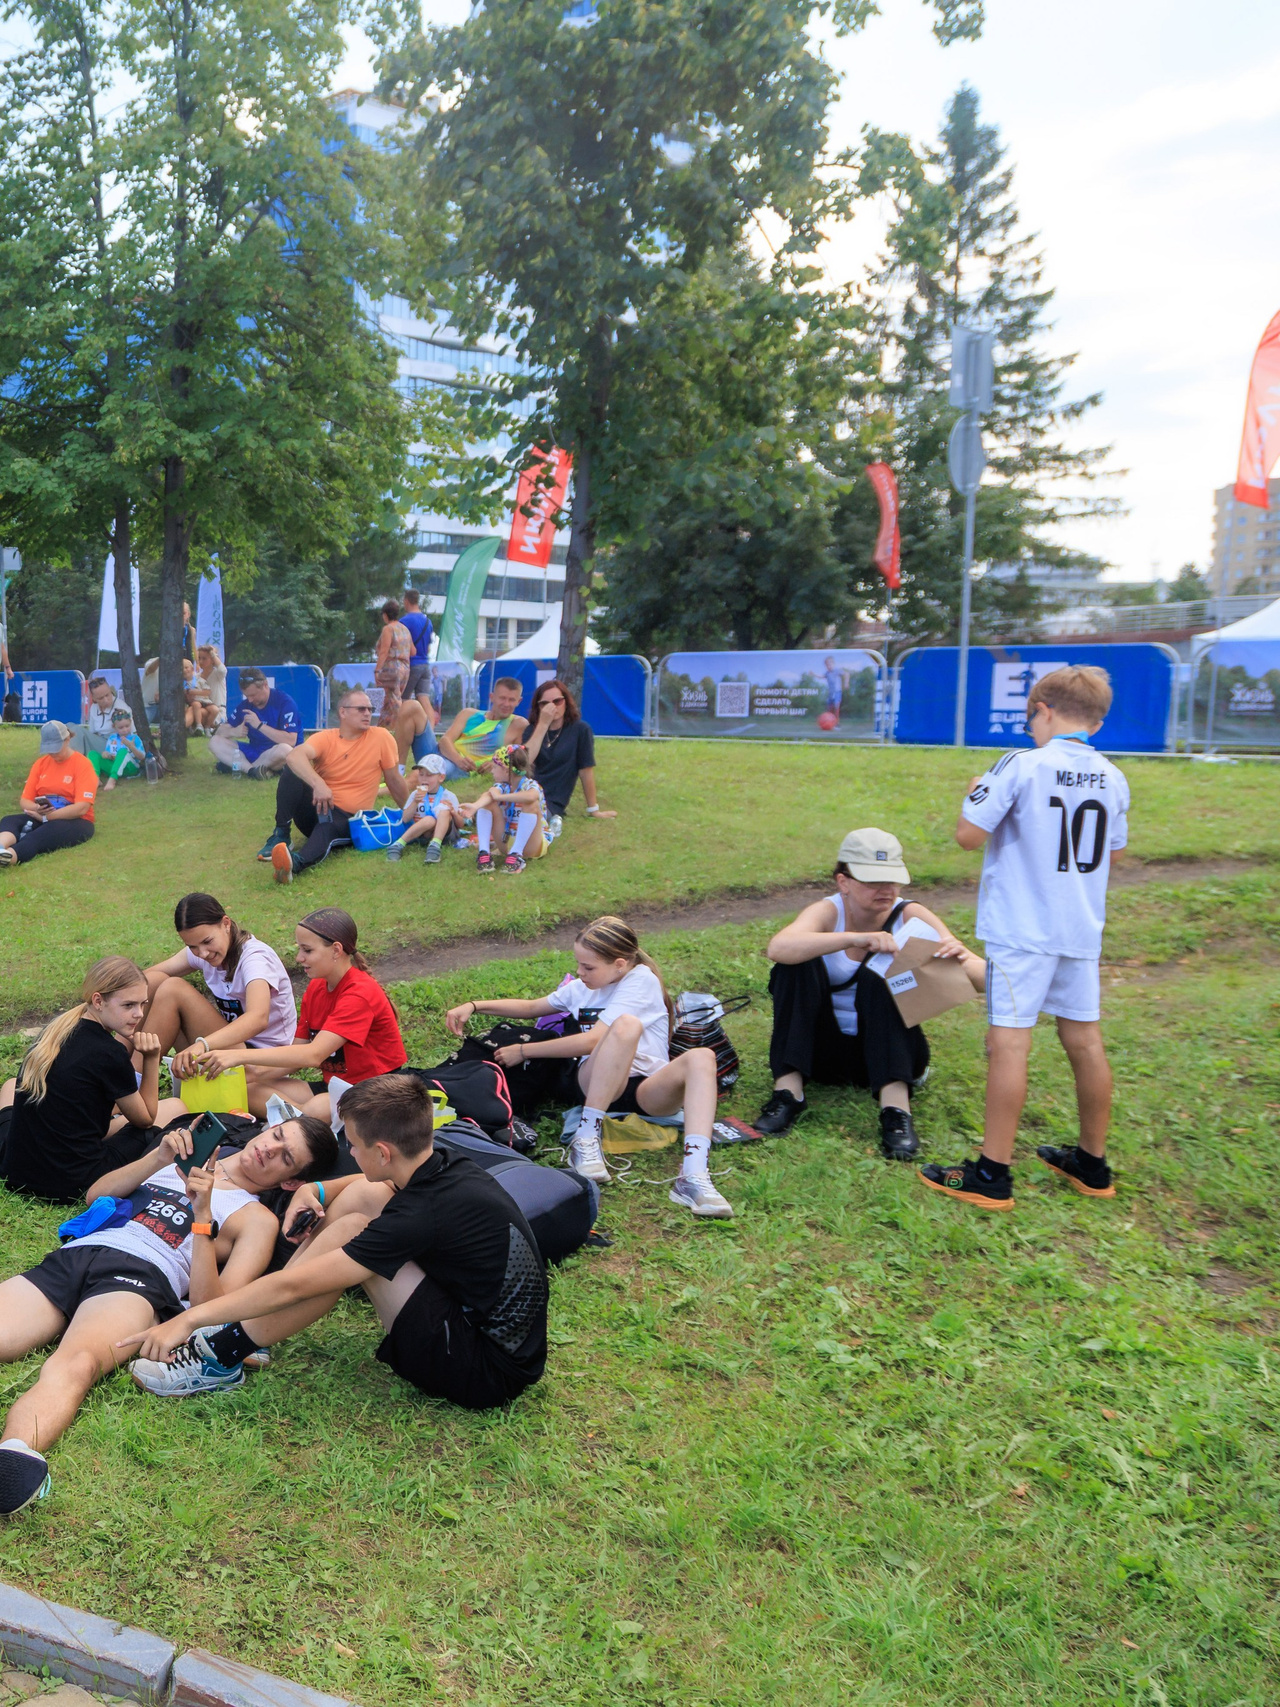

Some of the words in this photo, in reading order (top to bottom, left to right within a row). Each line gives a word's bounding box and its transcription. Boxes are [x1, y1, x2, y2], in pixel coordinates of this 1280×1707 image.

[756, 688, 789, 696] ПОМОГИ
[792, 688, 819, 696] ДЕТЯМ
[756, 698, 792, 707] СДЕЛАТЬ
[756, 707, 788, 716] ПЕРВЫЙ
[989, 712, 1028, 723] EUR
[1056, 770, 1108, 789] MBAPPÉ
[1049, 796, 1108, 873] 10
[891, 976, 914, 989] 15269
